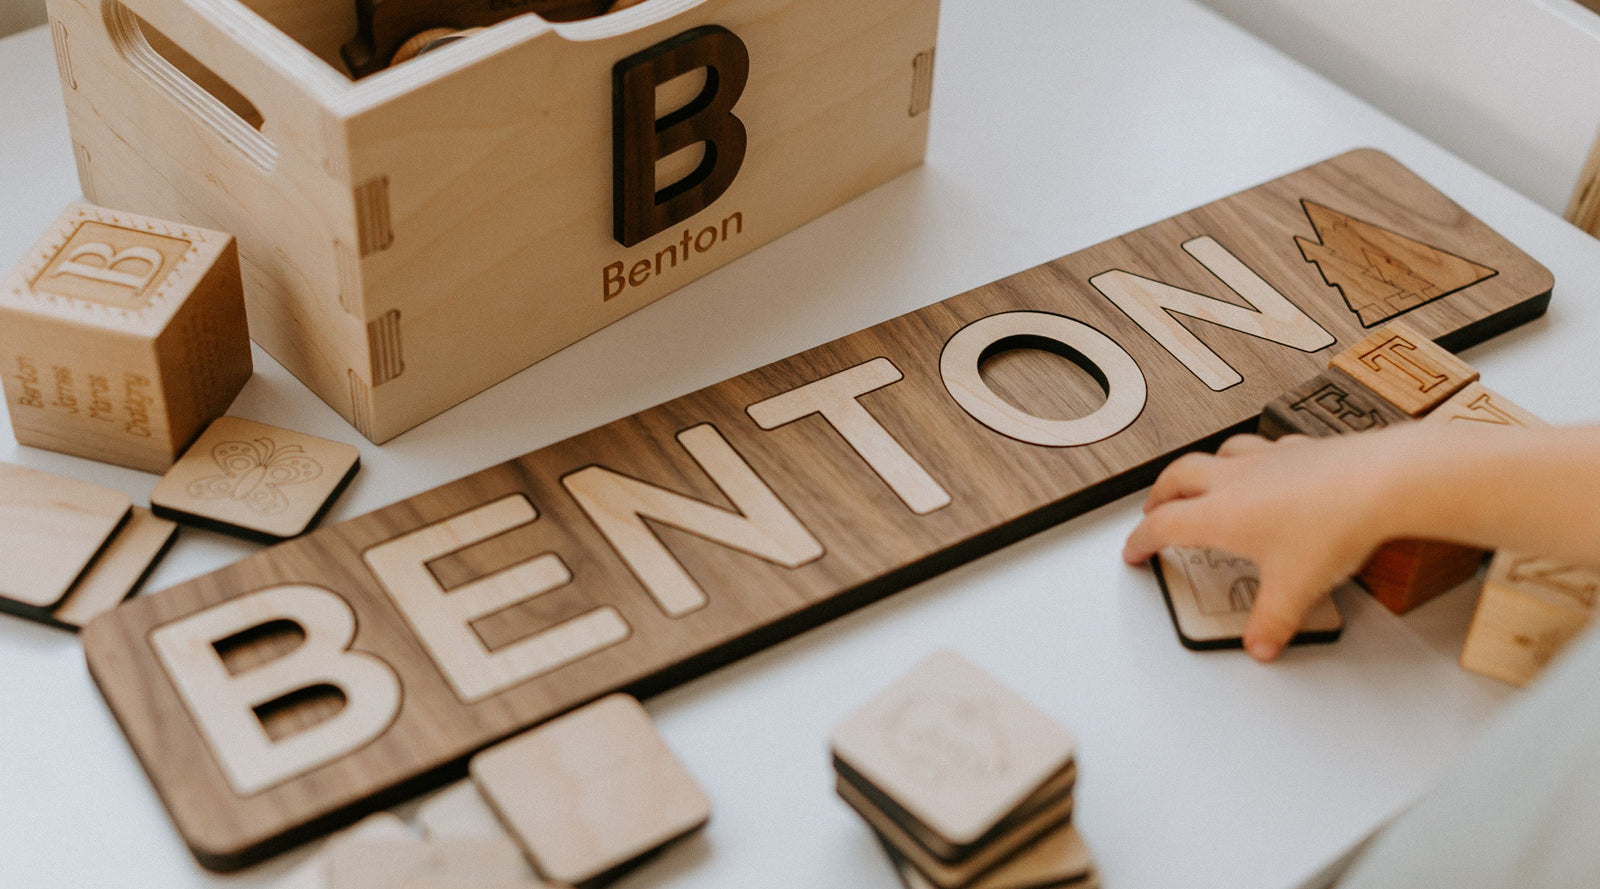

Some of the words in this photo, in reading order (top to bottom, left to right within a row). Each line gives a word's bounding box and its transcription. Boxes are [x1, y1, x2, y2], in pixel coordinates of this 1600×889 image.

[612, 24, 750, 248] B
[50, 242, 165, 297] B
[602, 211, 744, 302] Benton
[1358, 335, 1449, 393] T
[149, 236, 1336, 797] BENTON
